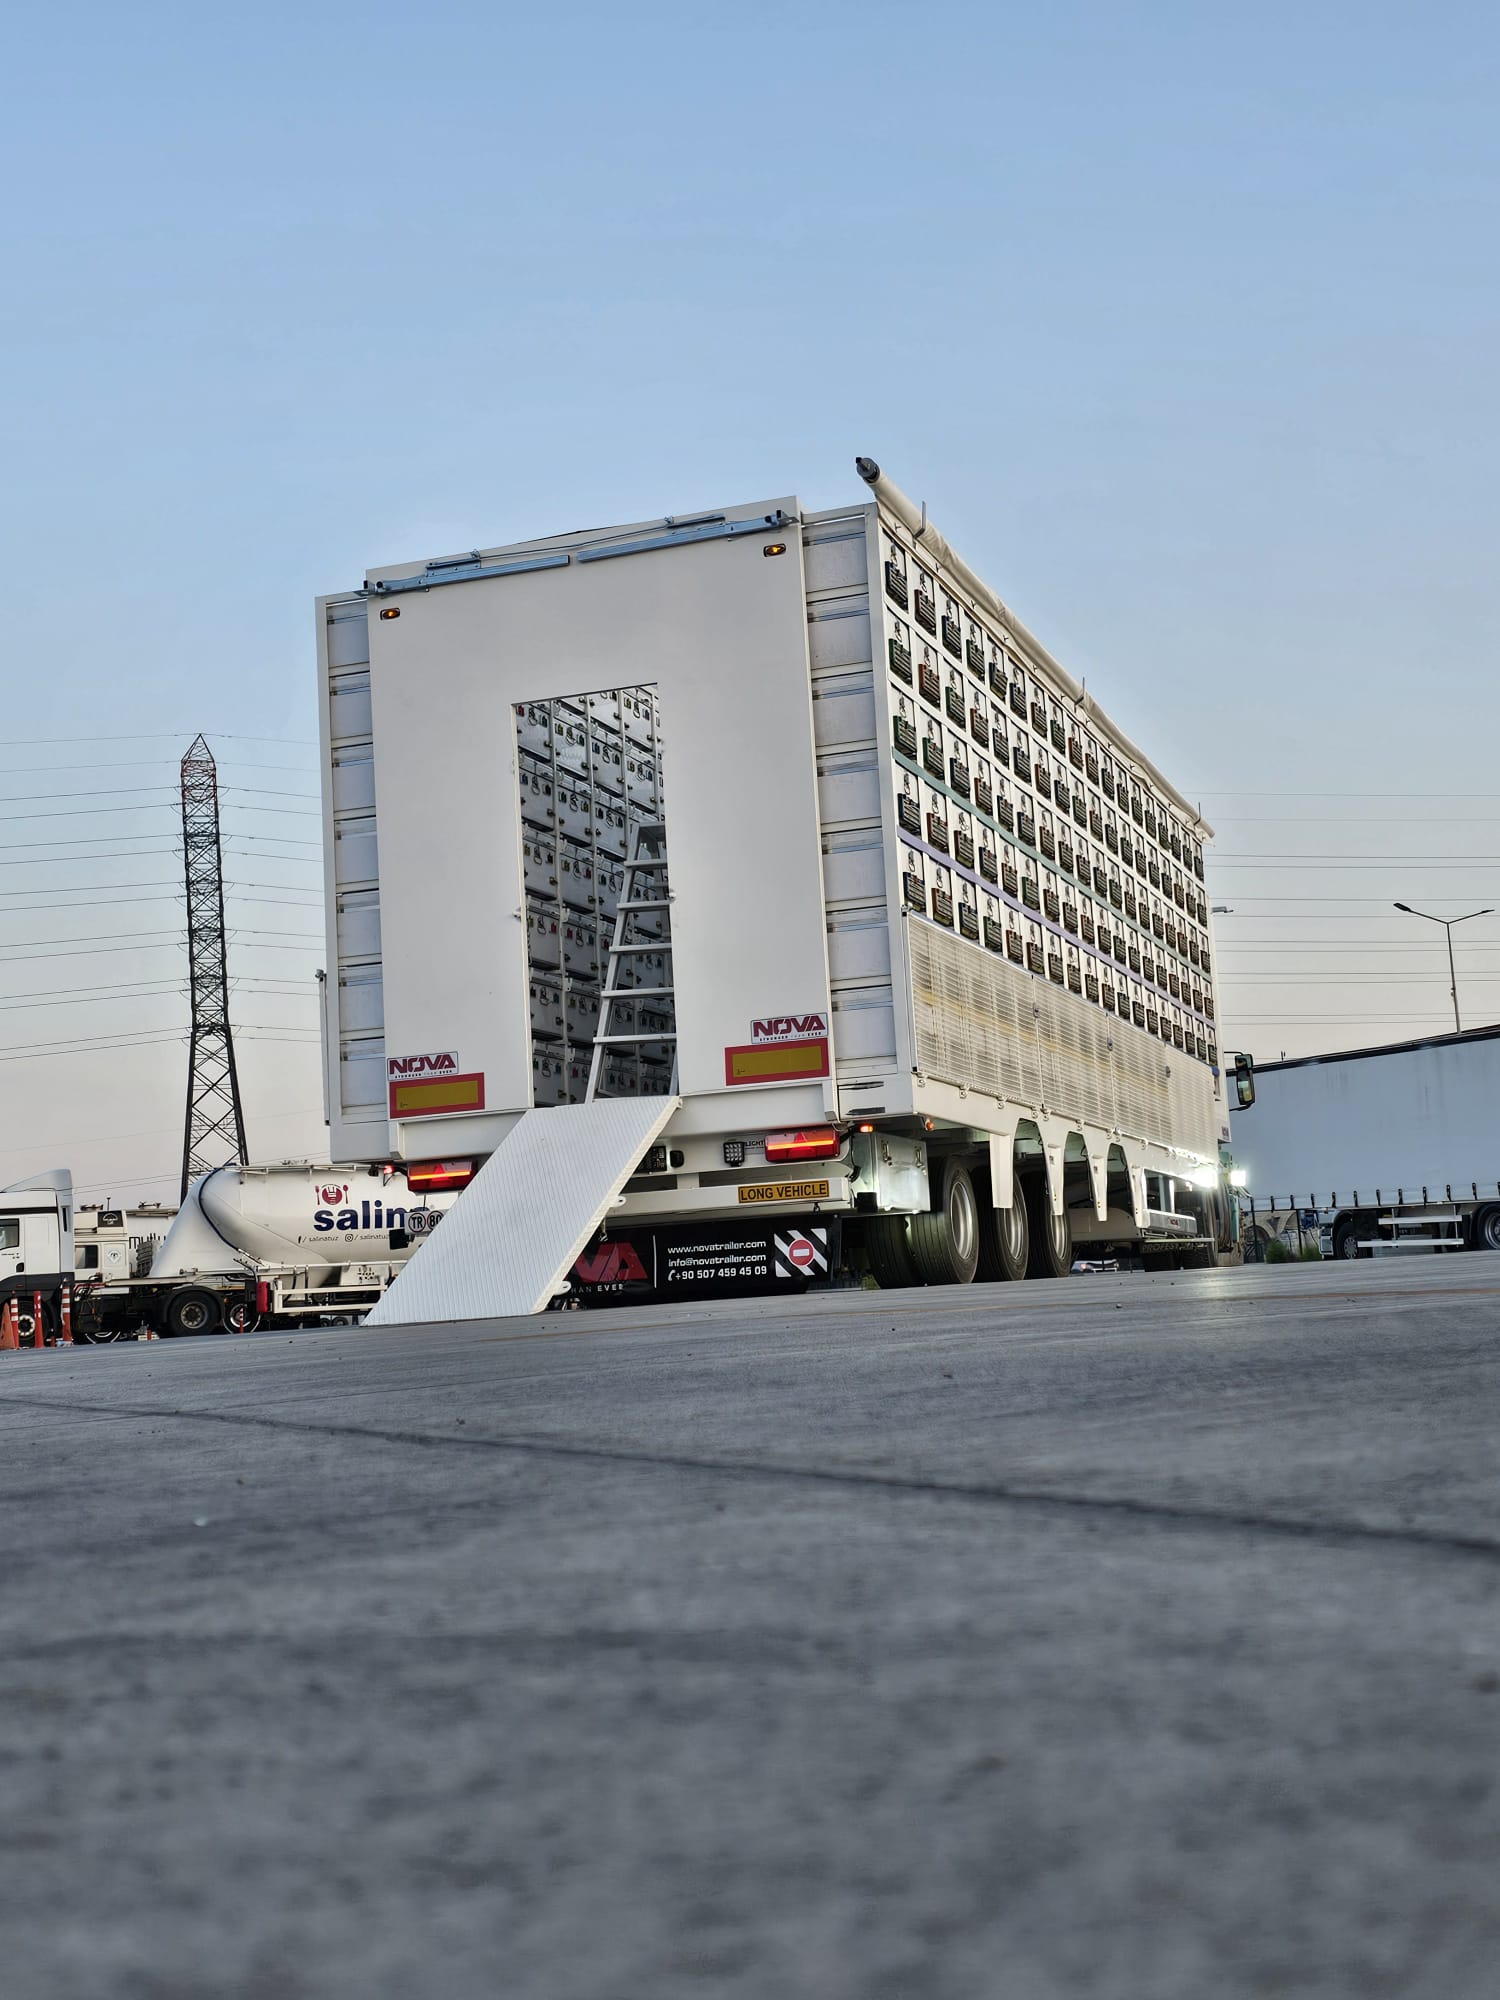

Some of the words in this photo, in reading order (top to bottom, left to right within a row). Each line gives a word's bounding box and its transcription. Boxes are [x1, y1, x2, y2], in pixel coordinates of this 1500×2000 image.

[753, 1015, 826, 1037] NOVA
[389, 1054, 456, 1075] NOVA
[741, 1187, 774, 1201] LONG
[777, 1183, 827, 1198] VEHICLE
[314, 1200, 430, 1232] salin
[411, 1216, 423, 1229] TR
[667, 1241, 767, 1254] www.novatrailer.com
[668, 1254, 767, 1267] info@novatrailer.com
[697, 1269, 715, 1279] 507
[717, 1267, 737, 1277] 459
[739, 1266, 752, 1276] 45
[754, 1265, 767, 1275] 09
[571, 1286, 592, 1294] HAN
[597, 1283, 624, 1292] EVER
